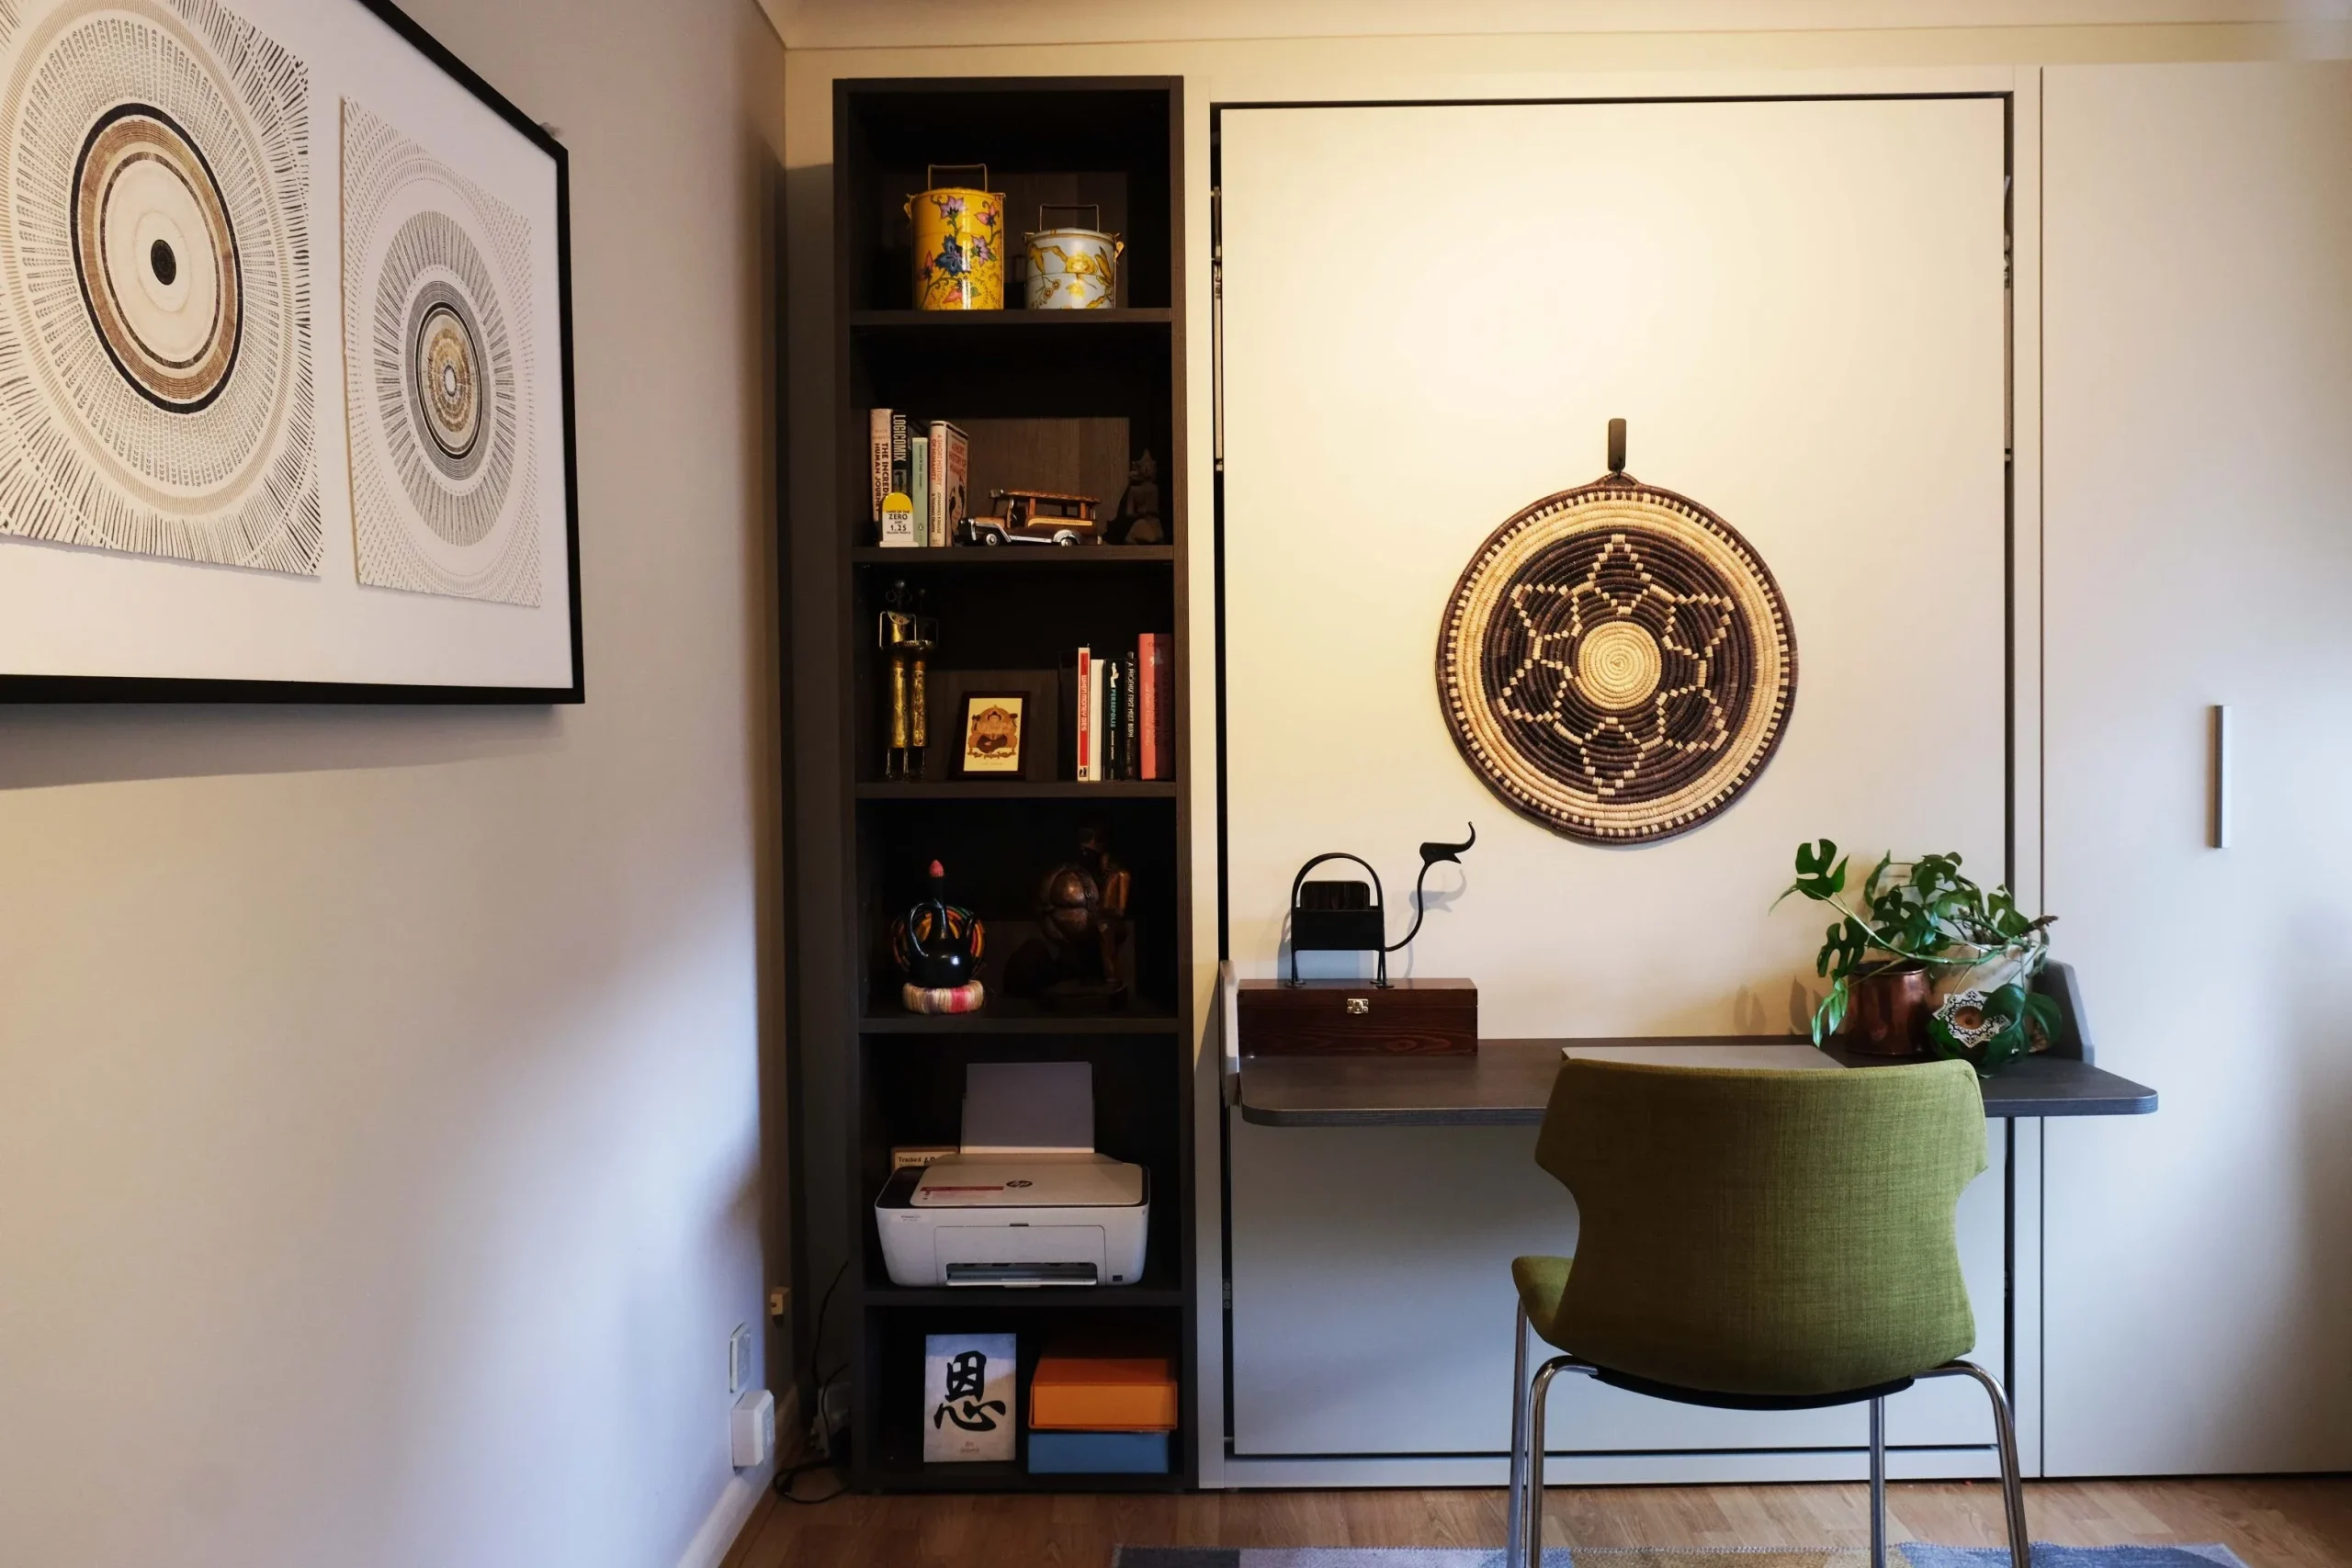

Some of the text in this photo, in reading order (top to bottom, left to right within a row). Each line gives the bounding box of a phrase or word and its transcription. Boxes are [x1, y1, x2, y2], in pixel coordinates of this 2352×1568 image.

[893, 414, 907, 462] LOGICOMIX
[881, 442, 889, 497] THE INCREDI
[933, 1350, 1006, 1431] 恩
